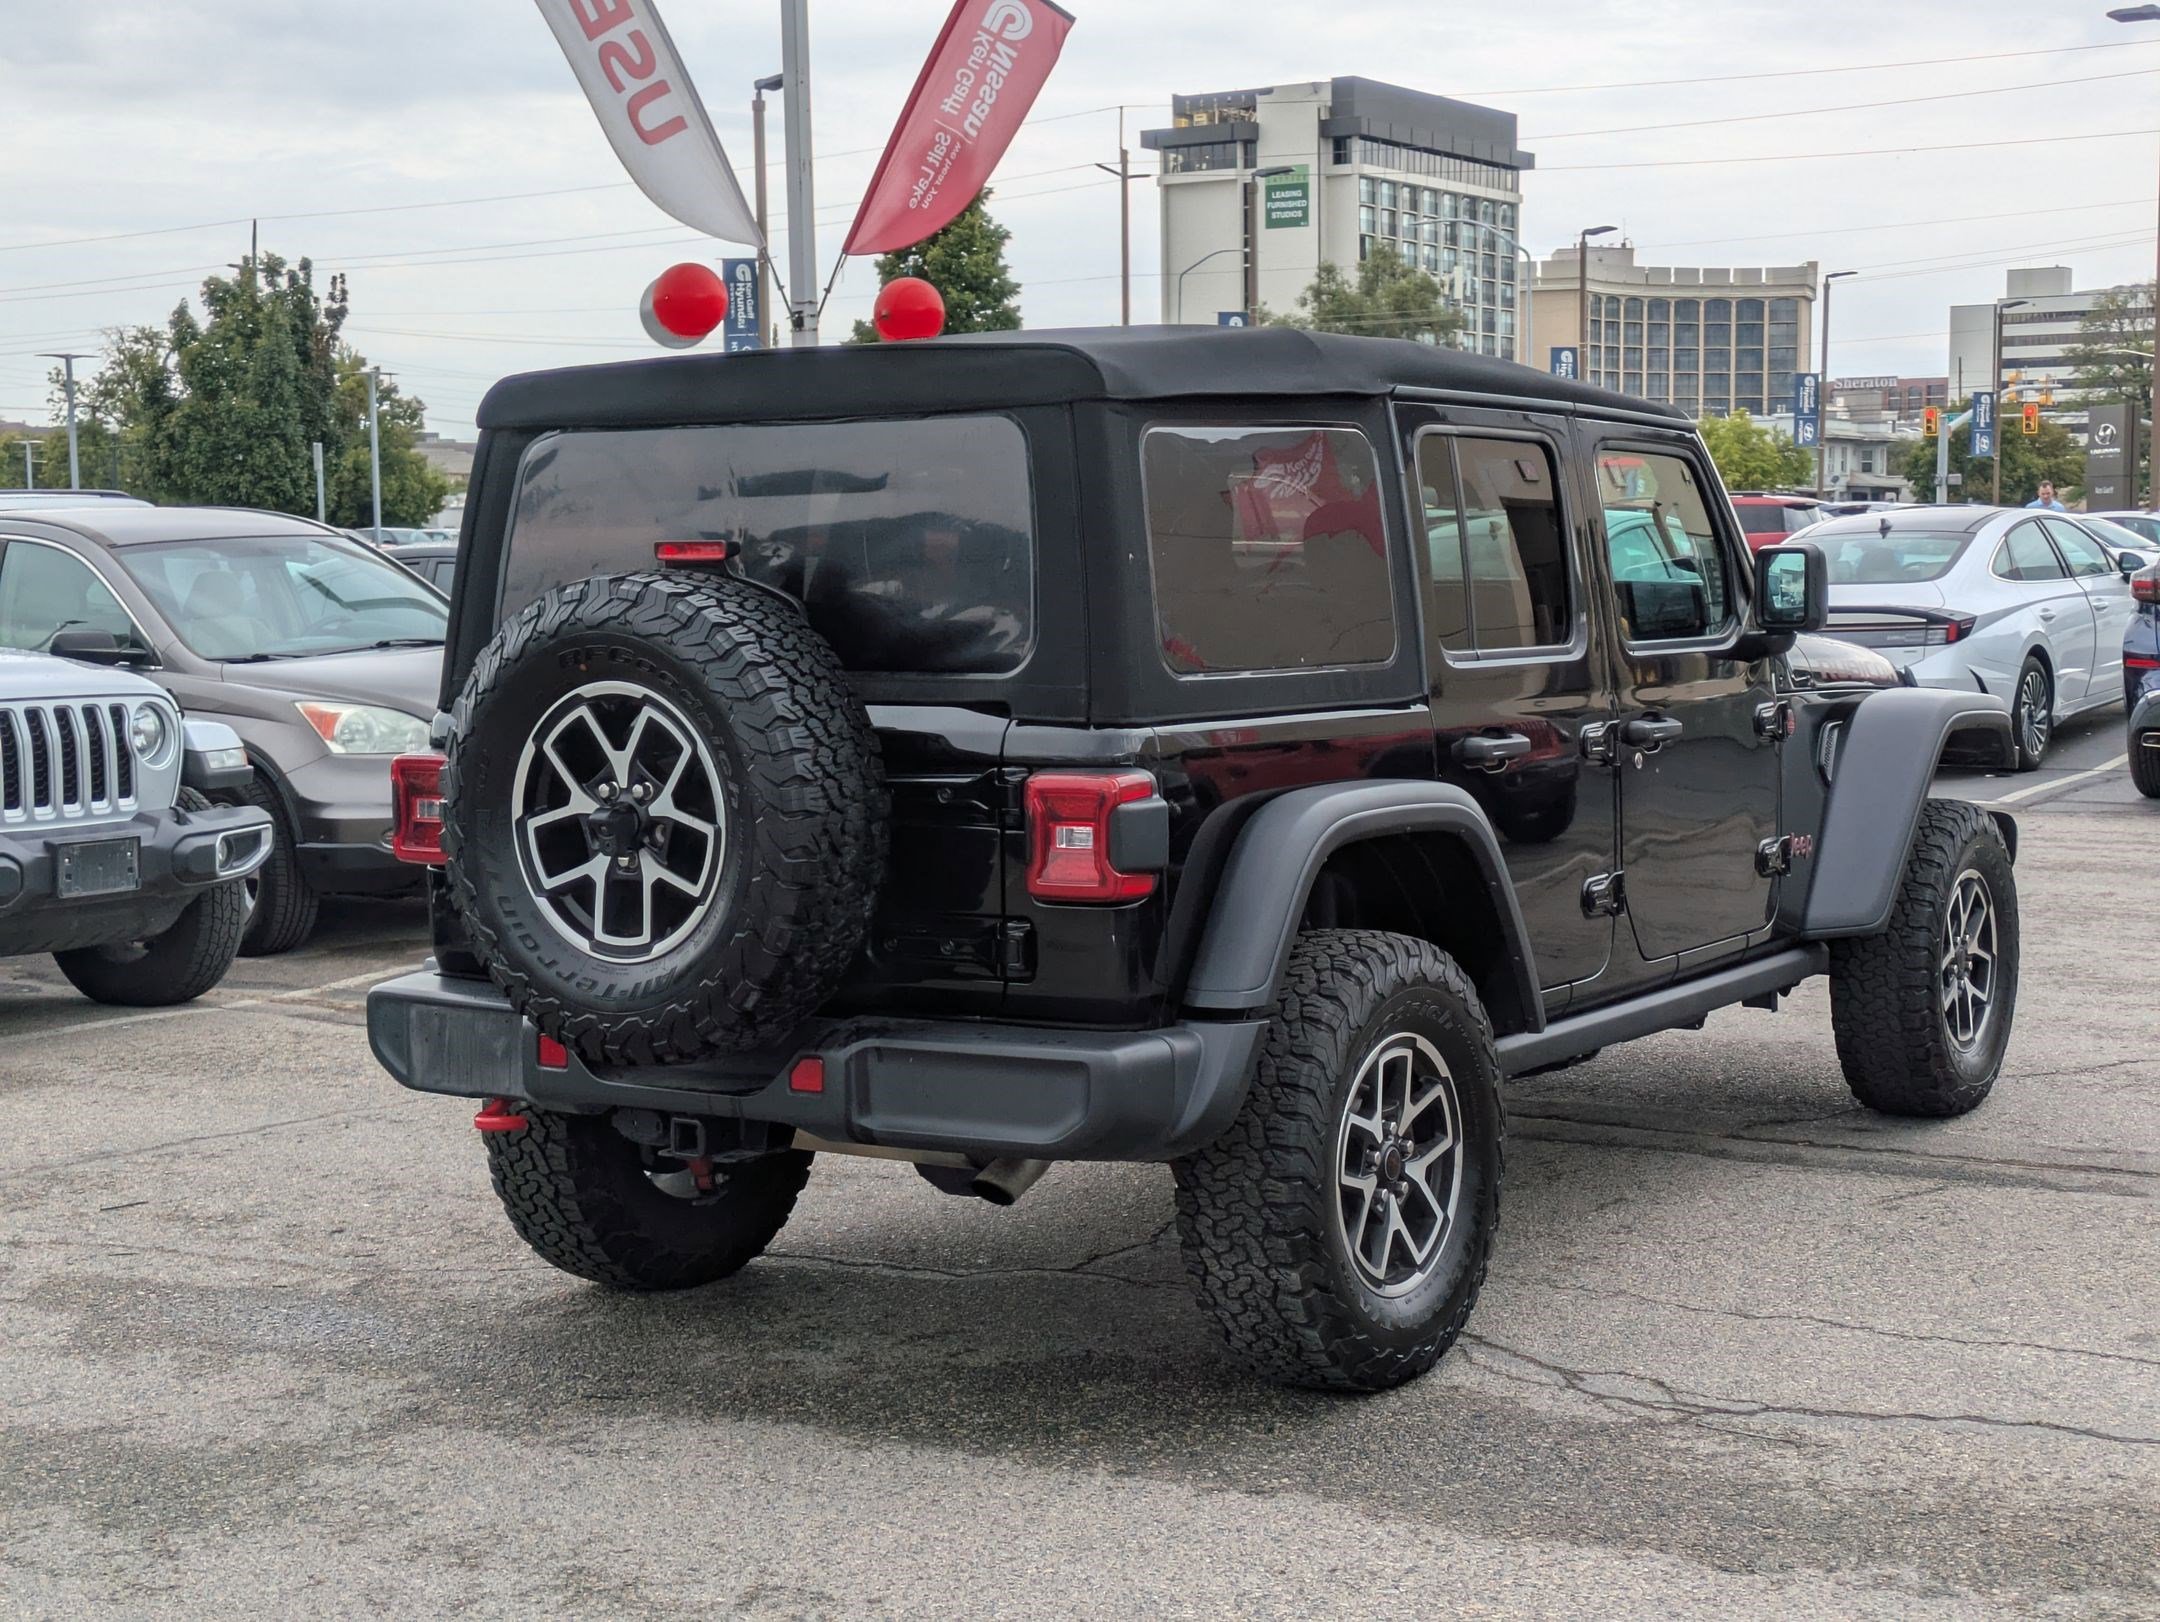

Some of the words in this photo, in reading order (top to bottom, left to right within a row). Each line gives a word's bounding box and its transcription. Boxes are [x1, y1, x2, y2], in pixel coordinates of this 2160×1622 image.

[1272, 190, 1302, 198] LEASING
[1267, 200, 1307, 208] FURNISHED
[1271, 210, 1303, 219] STUDIOS
[745, 282, 753, 299] Ken
[735, 282, 746, 329] Hyundai
[1834, 377, 1897, 389] Sheraton
